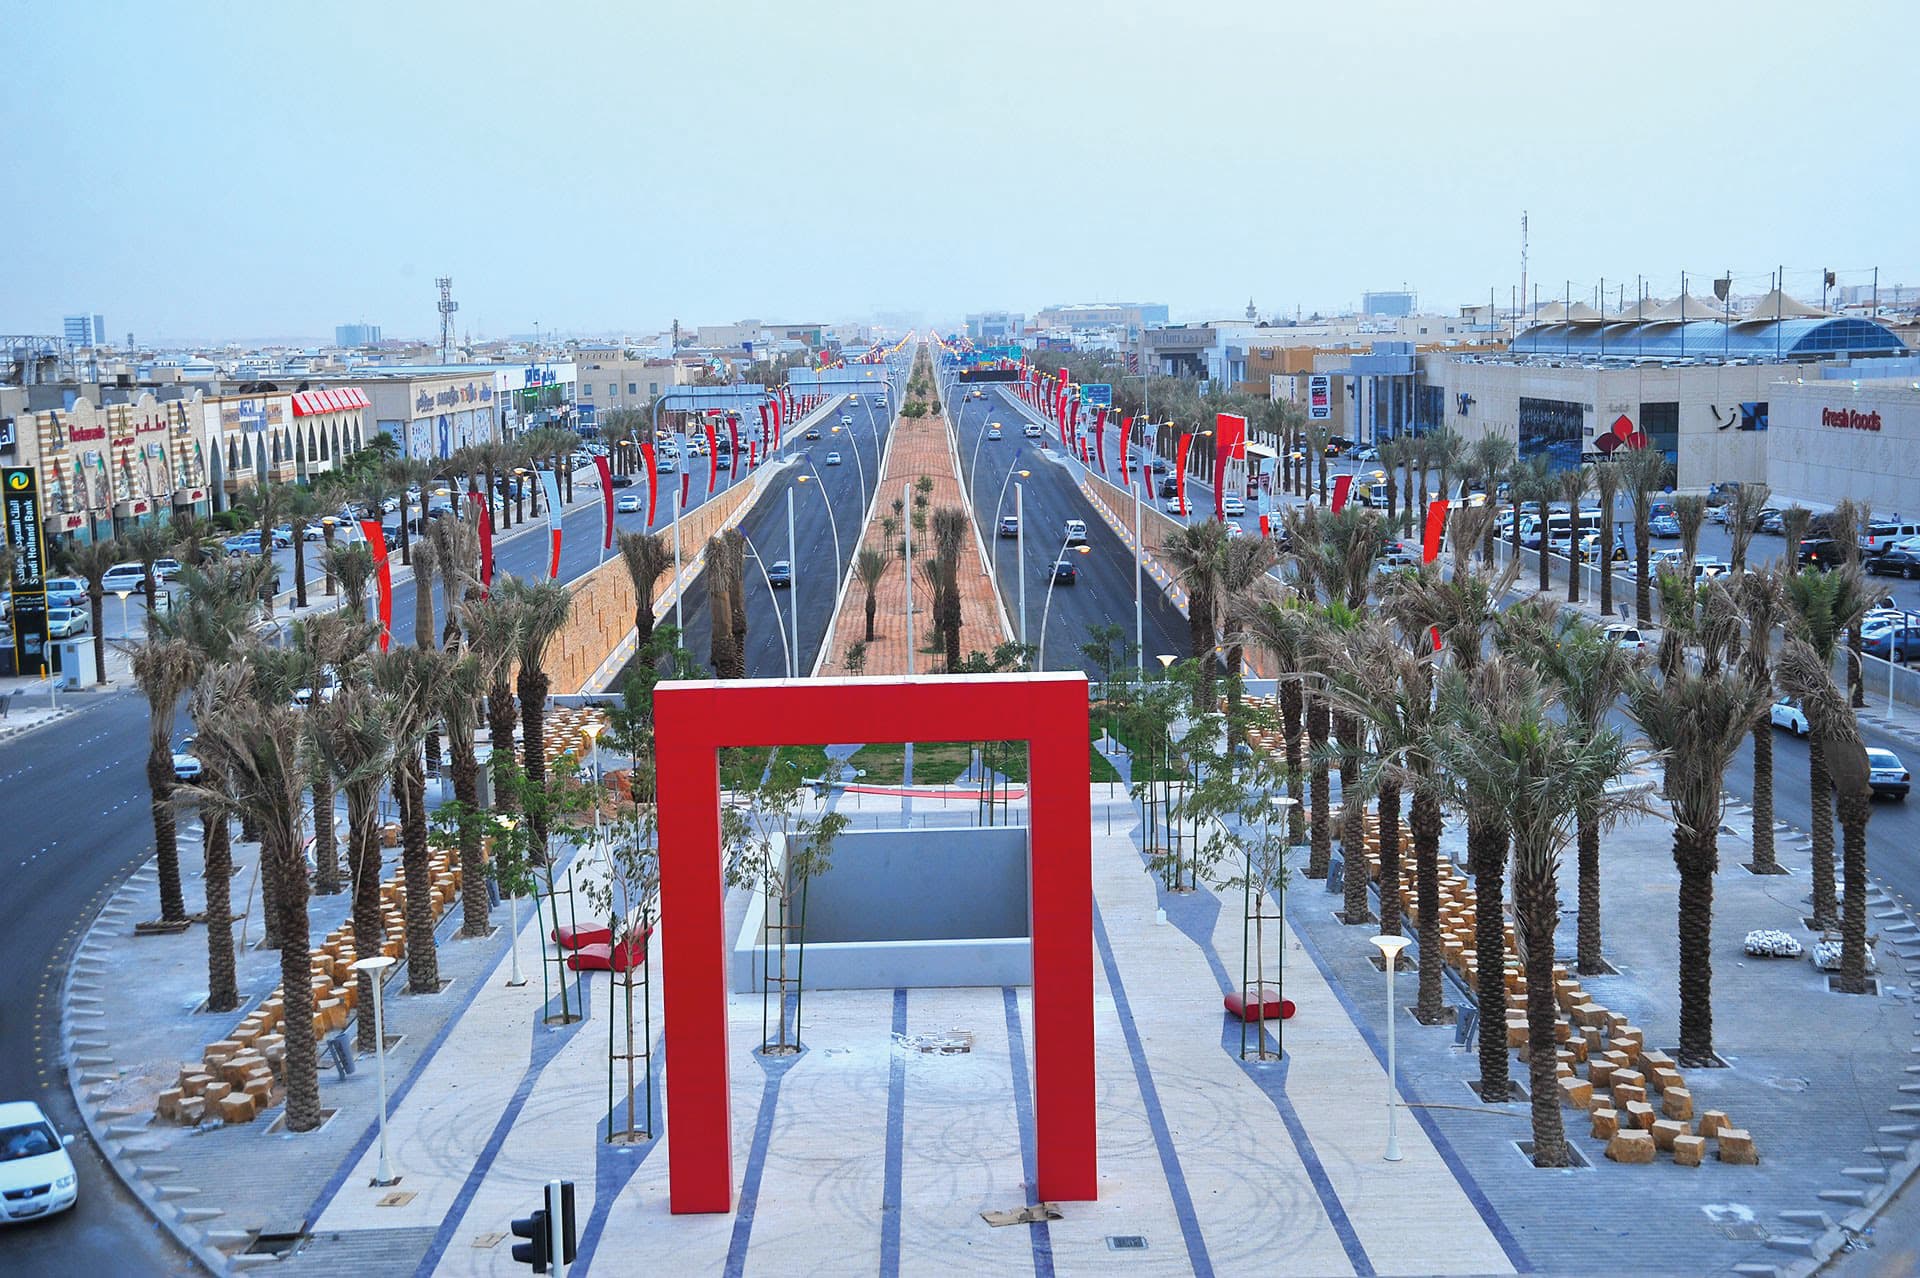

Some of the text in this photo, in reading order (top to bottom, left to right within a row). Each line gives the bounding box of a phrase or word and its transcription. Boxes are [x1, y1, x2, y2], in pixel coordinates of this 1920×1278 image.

[1822, 407, 1881, 431] Fresh Foods
[23, 499, 34, 522] Bank
[25, 523, 37, 559] Hollandi
